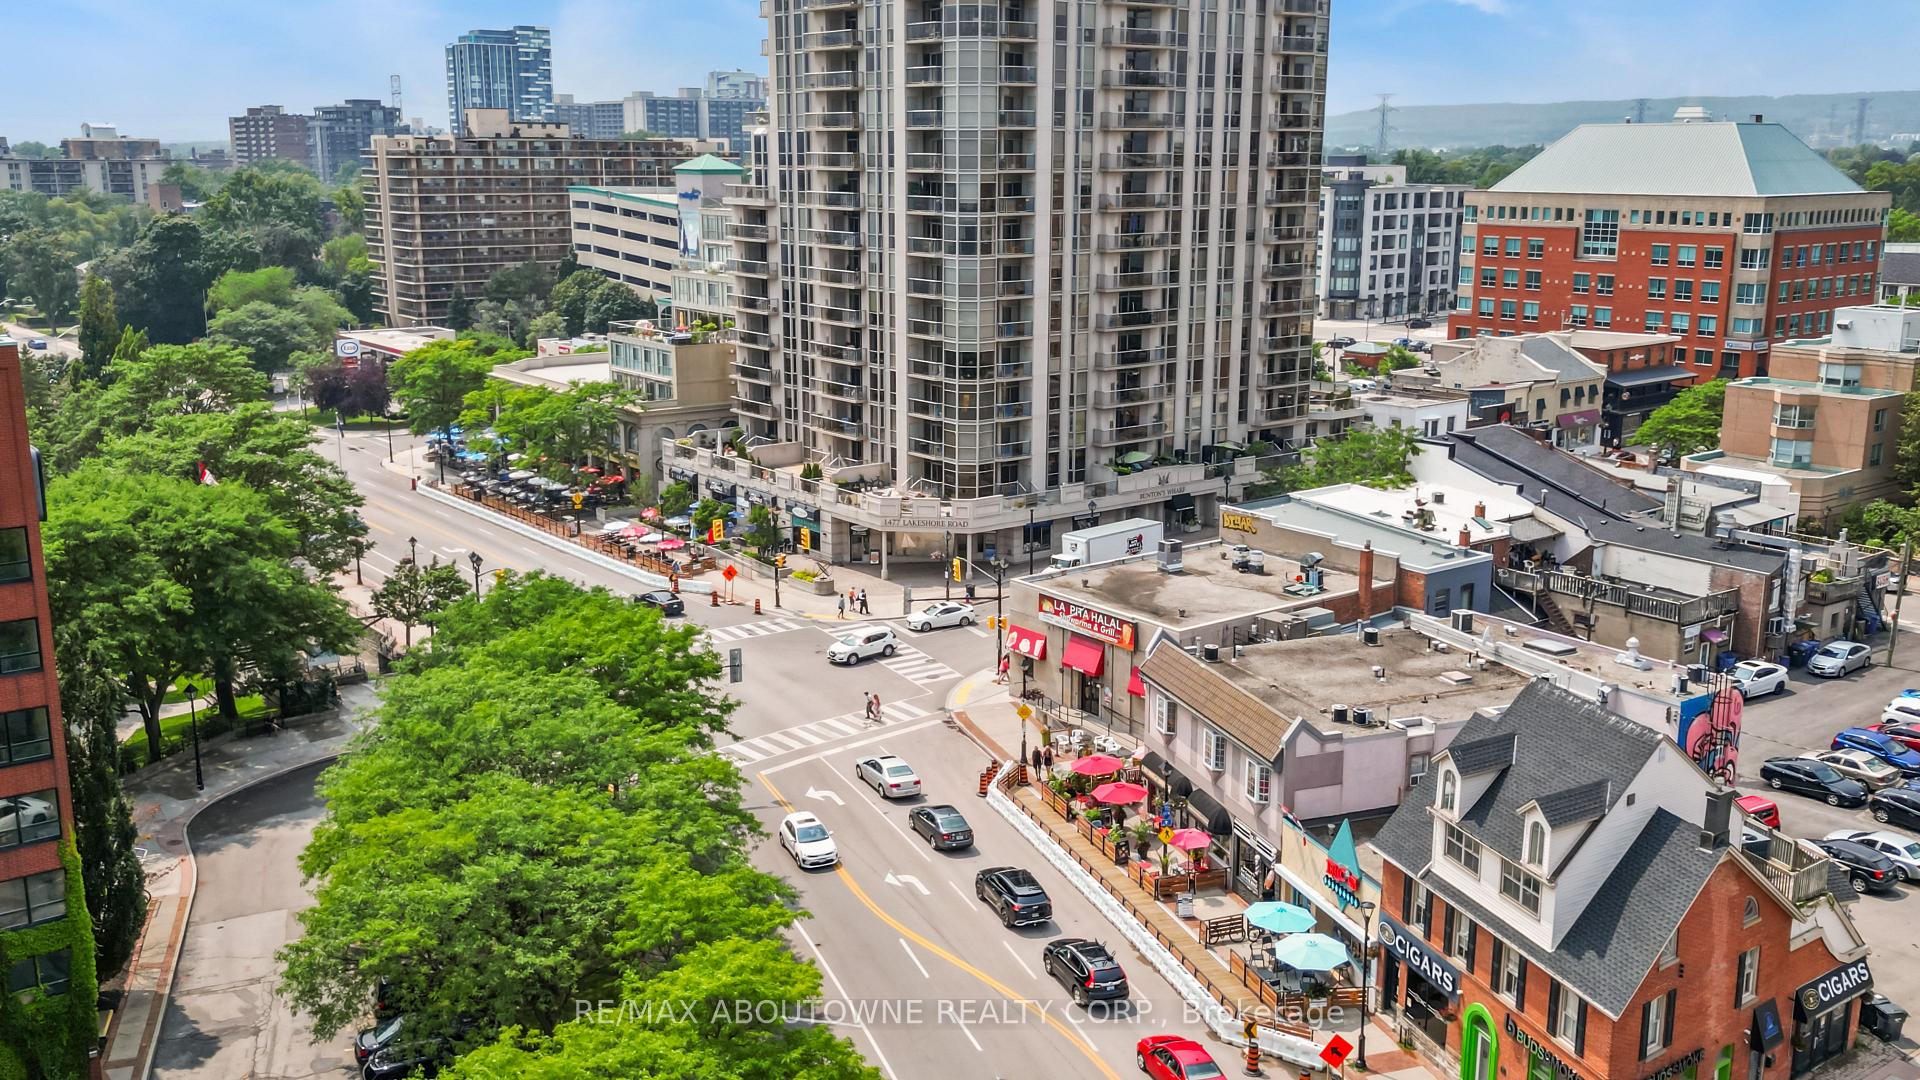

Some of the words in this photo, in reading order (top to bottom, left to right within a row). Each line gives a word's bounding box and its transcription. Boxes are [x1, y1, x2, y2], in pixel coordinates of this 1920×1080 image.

[884, 519, 900, 527] 1477
[902, 519, 945, 527] LAKESHORE
[947, 520, 969, 528] ROAD
[1054, 600, 1065, 612] LA
[1070, 605, 1089, 620] PITA
[1091, 612, 1121, 630] HALAL
[1093, 623, 1098, 632] &
[1100, 625, 1115, 637] Grill
[1395, 934, 1453, 992] CIGARS
[1818, 962, 1869, 1002] CIGARS
